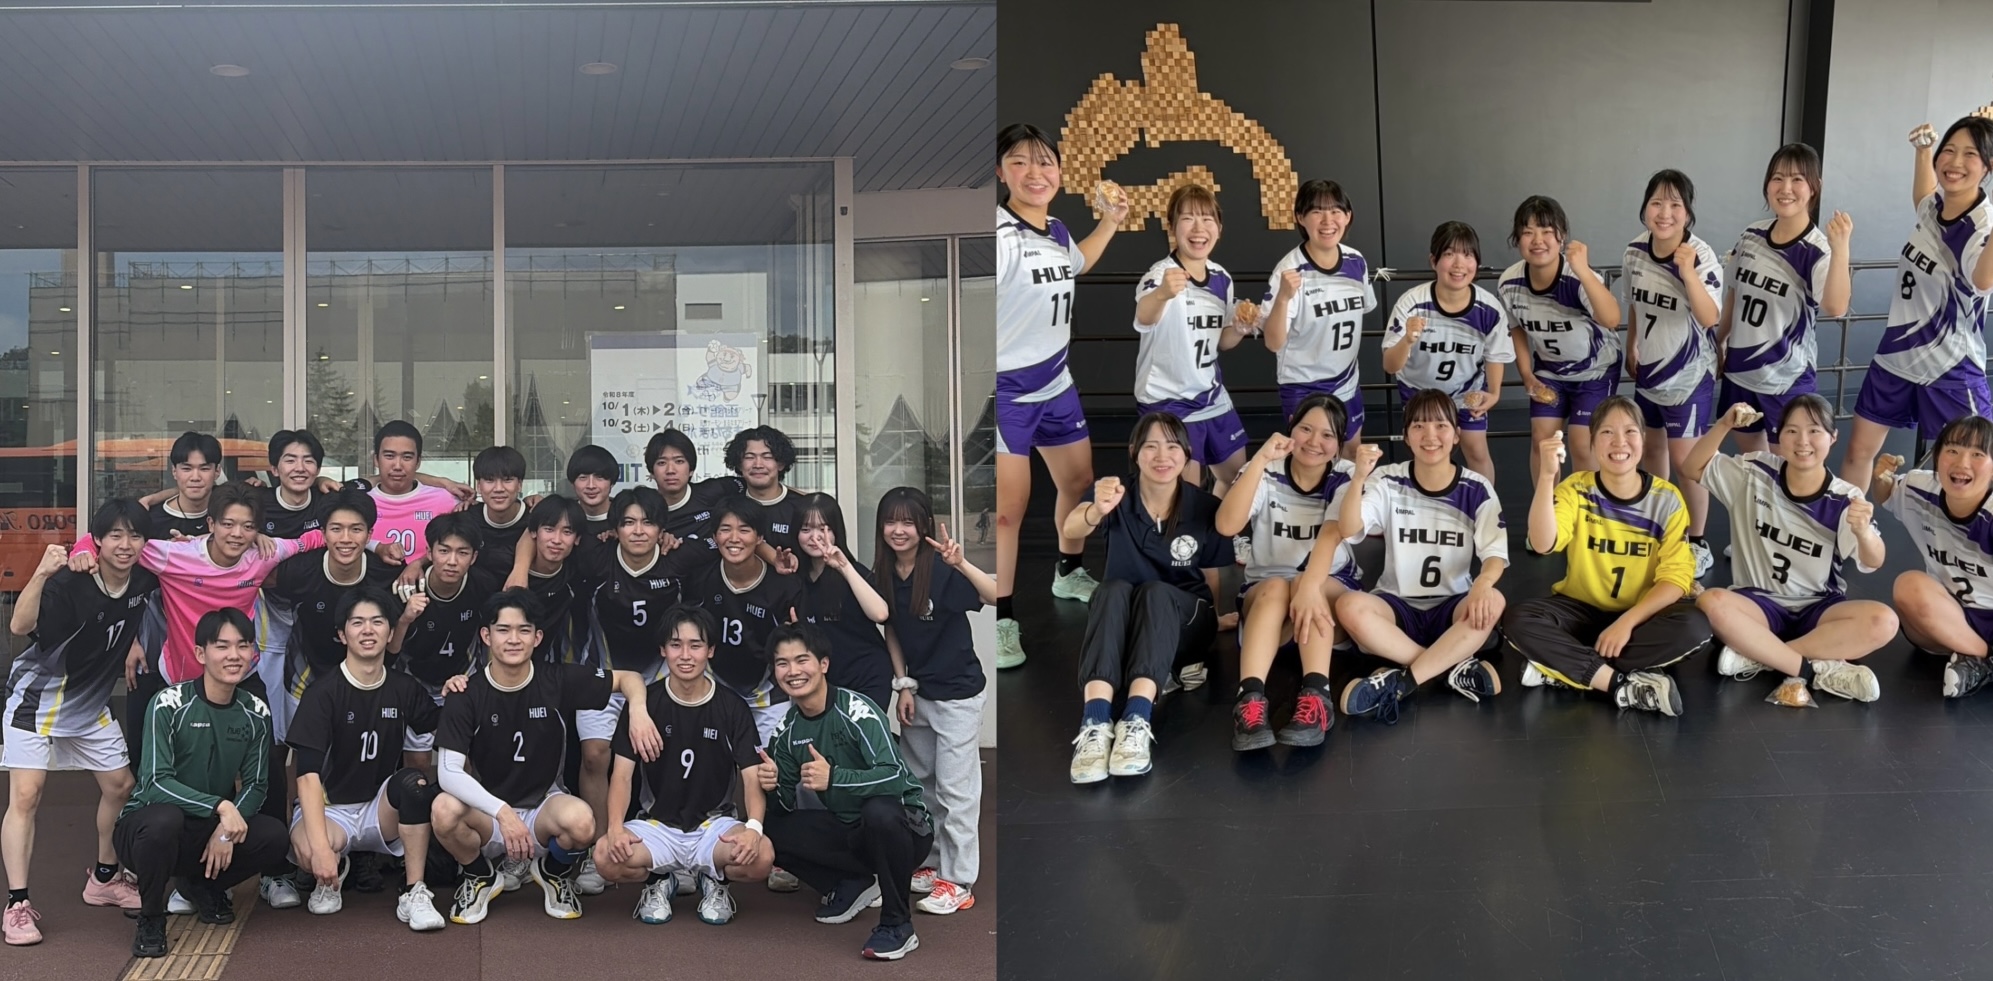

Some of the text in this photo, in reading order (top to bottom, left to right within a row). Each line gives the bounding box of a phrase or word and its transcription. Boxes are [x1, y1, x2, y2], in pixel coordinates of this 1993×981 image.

[1031, 265, 1074, 284] HUE
[1735, 266, 1790, 298] HUEI
[1901, 270, 1917, 300] 8
[1051, 291, 1071, 327] 11
[1313, 295, 1365, 318] HUEI
[1632, 286, 1678, 311] HUEI
[1741, 294, 1768, 328] 10
[1187, 315, 1223, 331] HUEI
[1331, 320, 1356, 351] 13
[1519, 317, 1574, 333] HUEI
[1645, 312, 1658, 340] 7
[1419, 341, 1477, 355] HUEI
[1543, 339, 1561, 356] 5
[1435, 360, 1456, 381] 9
[414, 511, 433, 521] HUEI
[772, 522, 790, 534] HUEI
[1273, 521, 1322, 541] HU
[1399, 528, 1464, 547] HUEI
[1755, 518, 1823, 558] HUEI
[1587, 534, 1653, 557] HUEI
[1420, 555, 1441, 588] 6
[1772, 552, 1791, 585] 3
[1926, 543, 1988, 578] HUEI
[650, 578, 670, 590] HUEI
[1610, 566, 1626, 600] 1
[1952, 577, 1974, 605] 2
[460, 609, 473, 622] HEI
[632, 600, 648, 626] 5
[746, 603, 765, 619] HUEI
[105, 620, 126, 651] 17
[439, 631, 455, 657] 4
[722, 617, 743, 646] 13
[382, 708, 398, 718] HUEI
[529, 707, 547, 719] HUEI
[361, 730, 379, 762] 10
[513, 731, 526, 761] 2
[681, 748, 695, 779] 9
